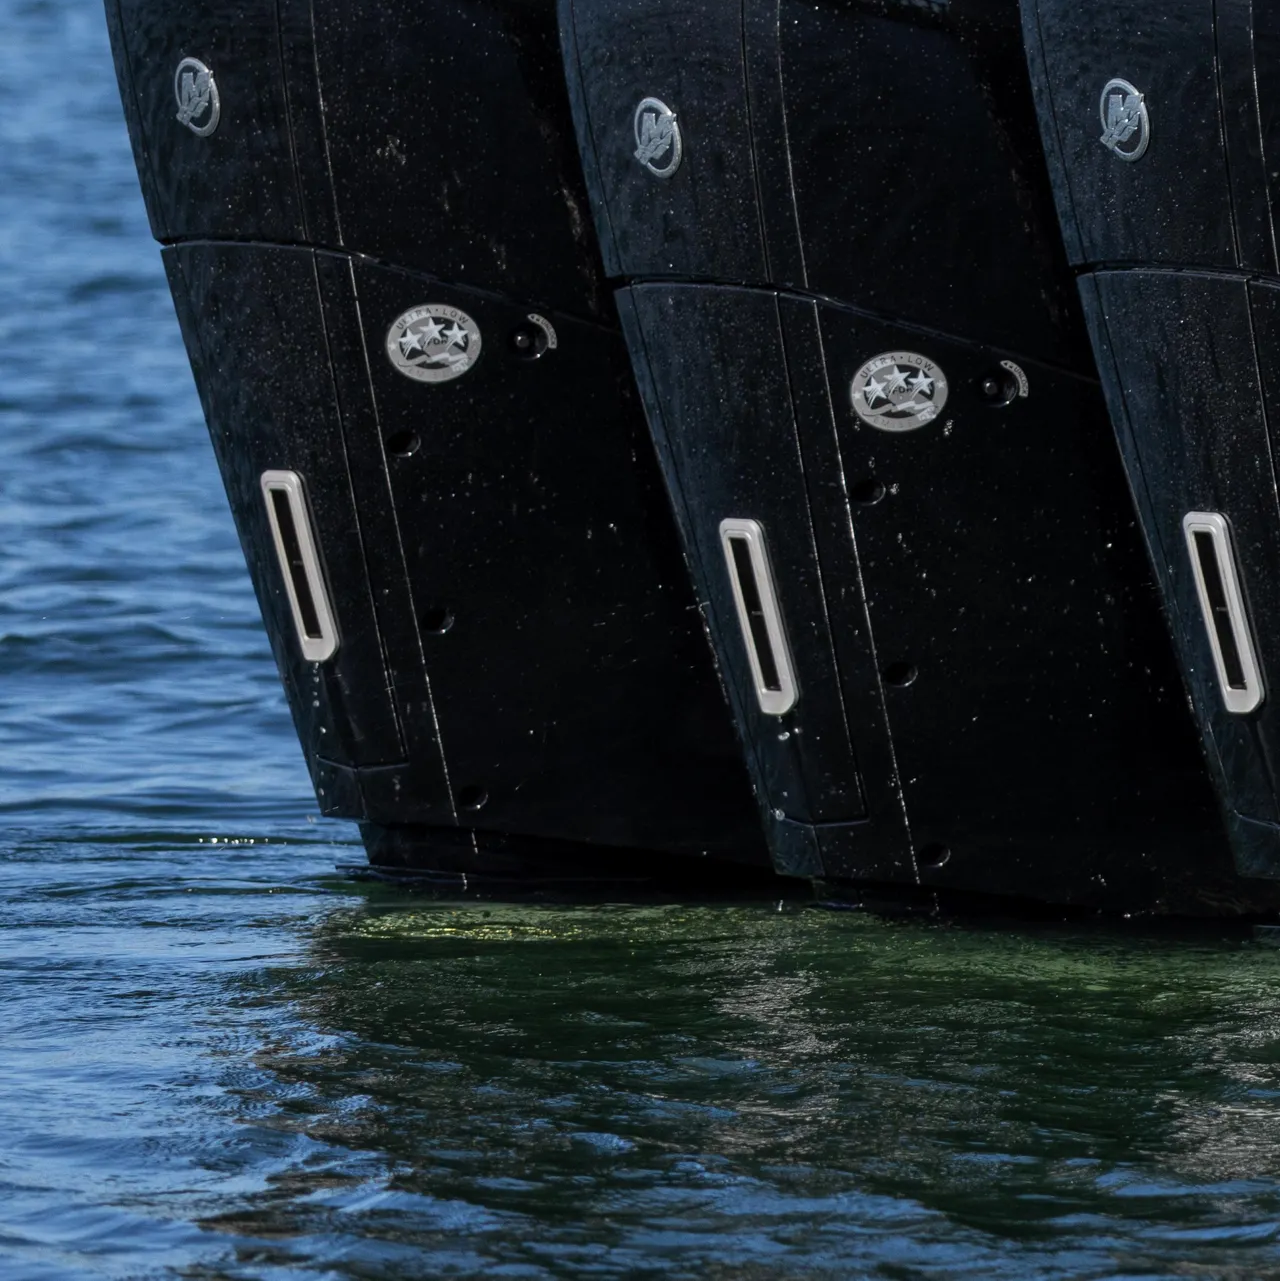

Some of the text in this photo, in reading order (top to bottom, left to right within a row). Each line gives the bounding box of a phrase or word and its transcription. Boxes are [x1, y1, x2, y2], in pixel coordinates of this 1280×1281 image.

[443, 307, 470, 324] LOW
[860, 355, 935, 379] ULTRA LOW
